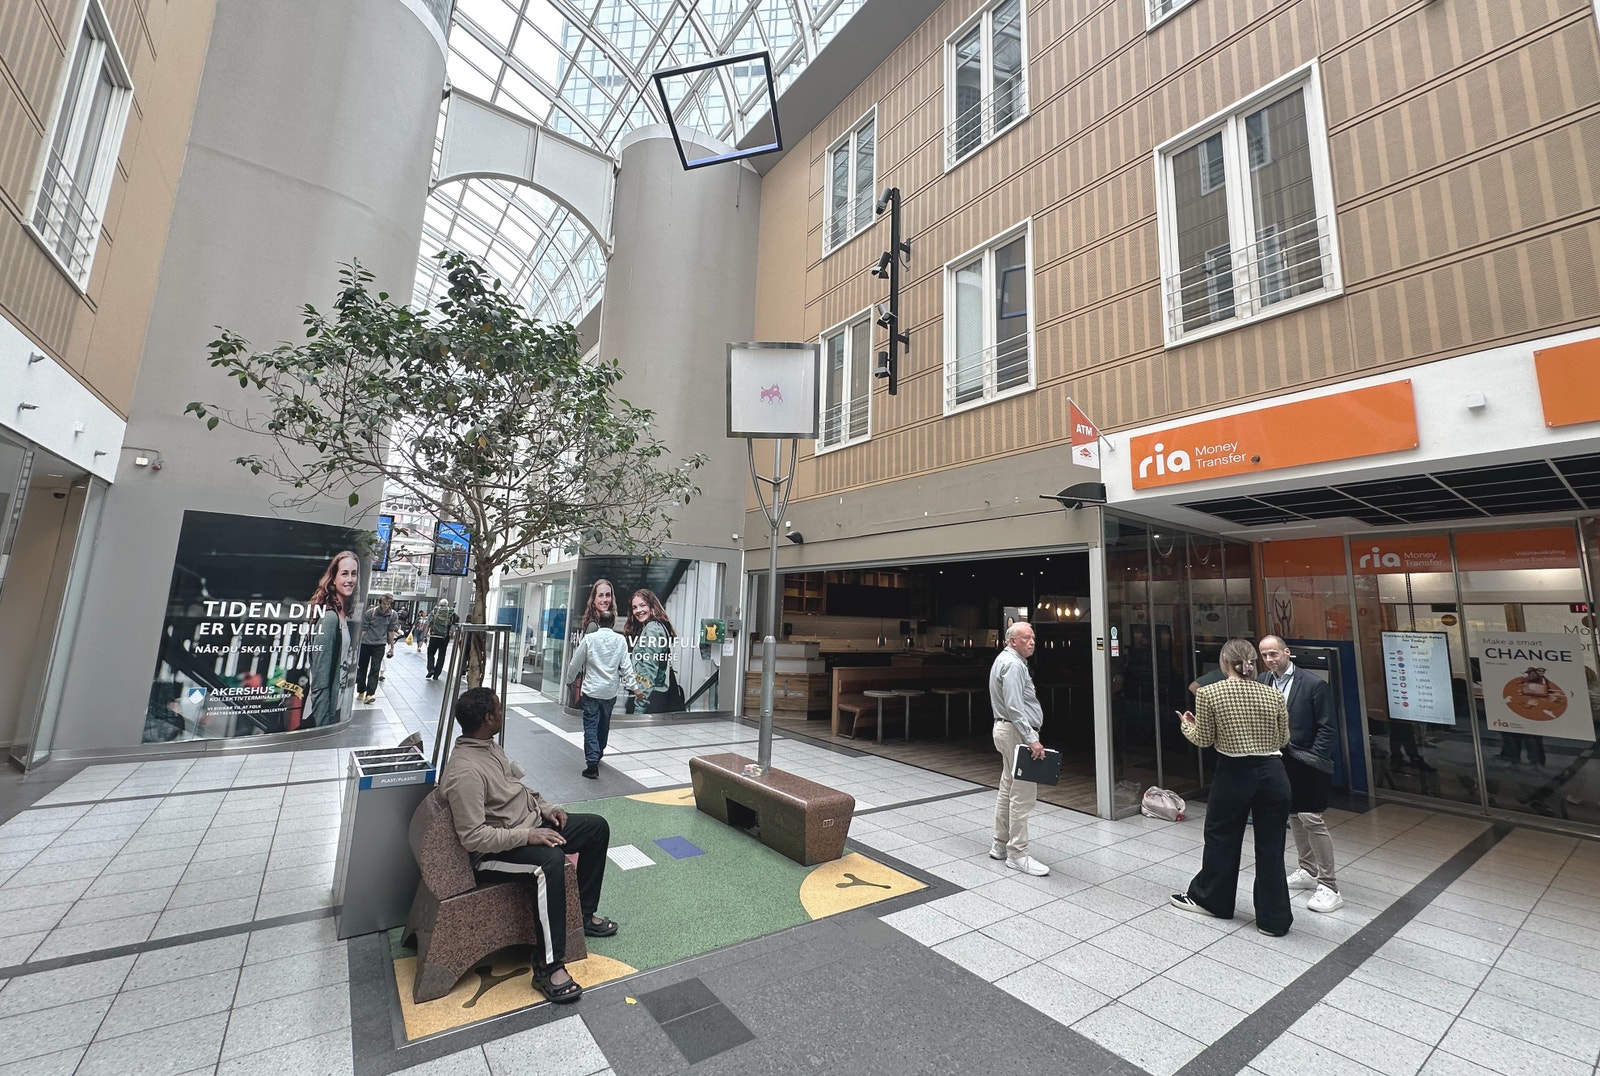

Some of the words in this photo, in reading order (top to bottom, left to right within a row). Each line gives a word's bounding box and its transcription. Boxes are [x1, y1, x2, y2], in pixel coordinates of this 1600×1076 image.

[1076, 424, 1093, 437] ATM
[1195, 442, 1238, 456] Money
[1139, 443, 1191, 478] ria
[1195, 453, 1247, 468] Transfer
[1360, 546, 1401, 568] ria
[1404, 552, 1437, 560] Money
[1404, 559, 1443, 567] Transfer
[203, 601, 281, 618] TIDEN
[289, 603, 327, 619] DIN
[199, 623, 224, 635] ER
[230, 623, 325, 636] VERDIFULL
[195, 643, 218, 653] NÅR
[241, 645, 267, 653] SKAL
[269, 645, 283, 653] UT
[285, 645, 299, 653] OG
[301, 644, 324, 652] REISE
[1485, 647, 1573, 662] CHANGE
[634, 652, 650, 661] OG
[653, 653, 679, 661] REISE
[210, 686, 276, 696] AKERSHUS
[1493, 719, 1509, 728] ria
[381, 776, 417, 784] PLAST/PLASTIC
